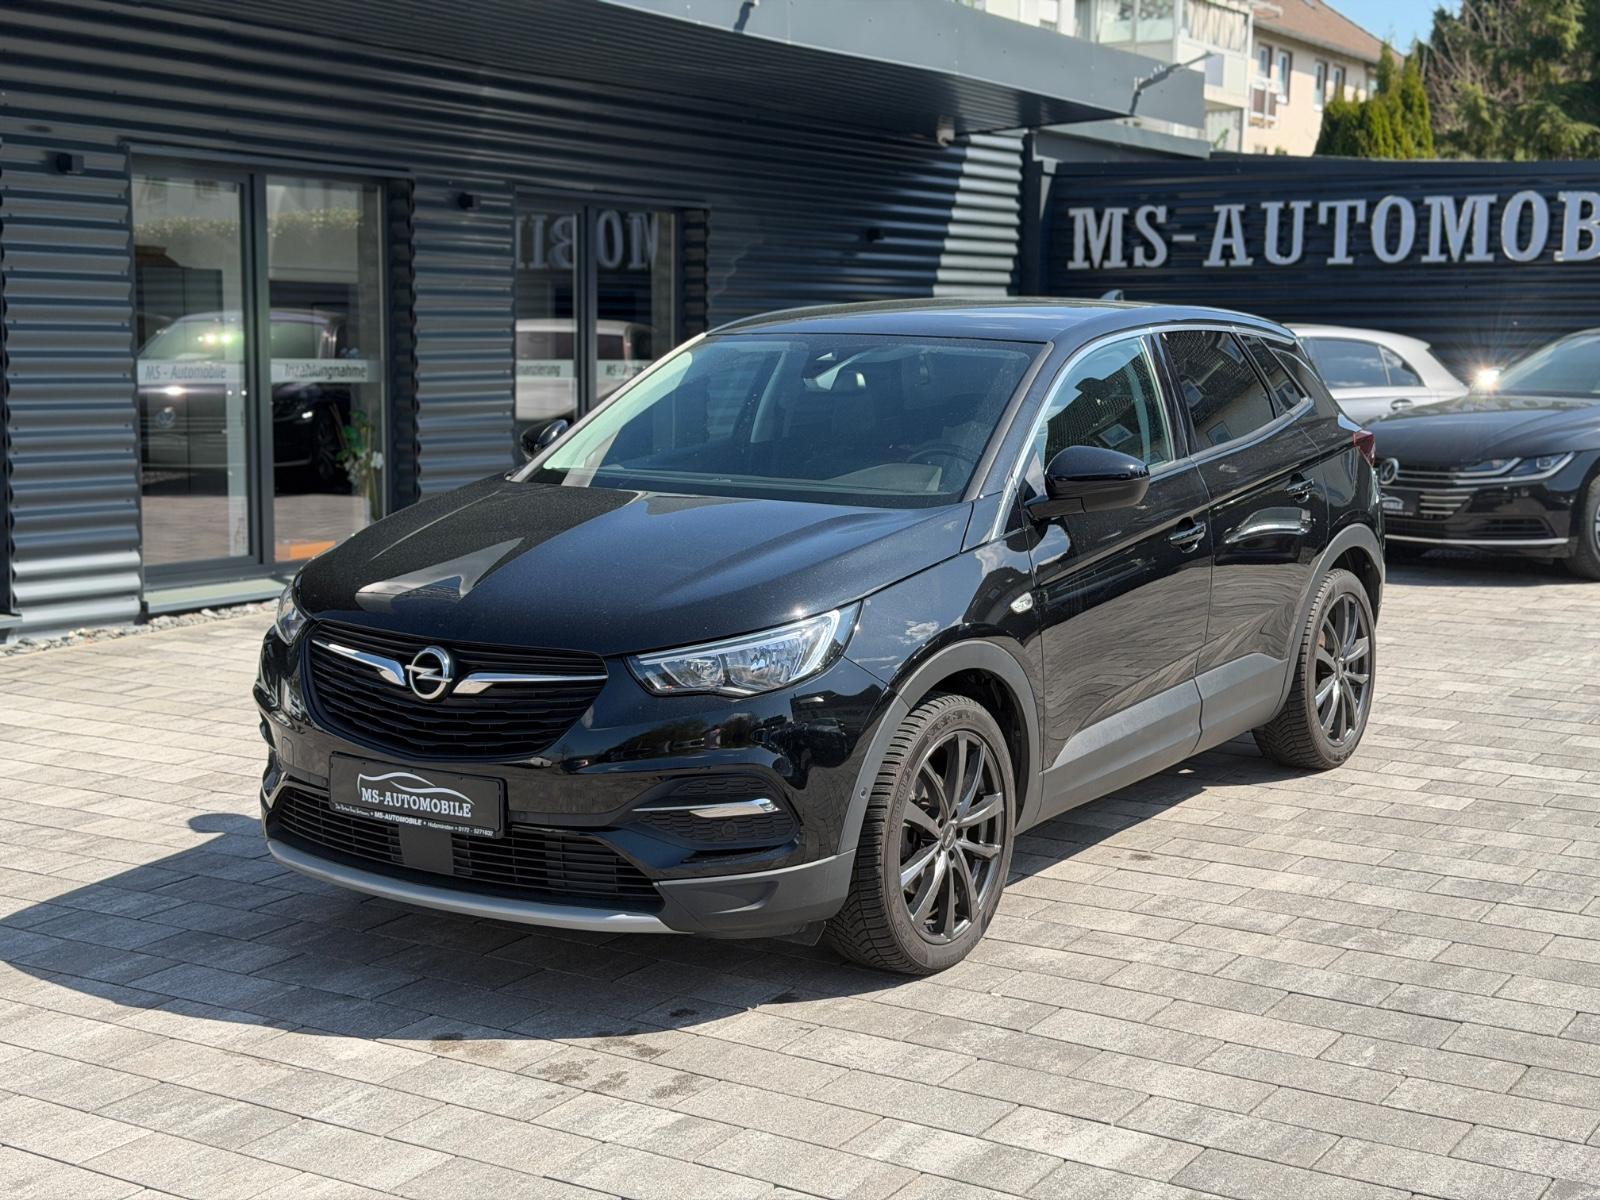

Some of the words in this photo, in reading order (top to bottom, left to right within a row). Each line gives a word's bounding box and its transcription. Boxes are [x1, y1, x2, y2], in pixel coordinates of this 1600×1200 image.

[1067, 190, 1600, 270] MS-AUTOMOB
[361, 787, 472, 818] MS-AUTOMOBILE
[374, 811, 422, 826] MS-AUTOMOBILE
